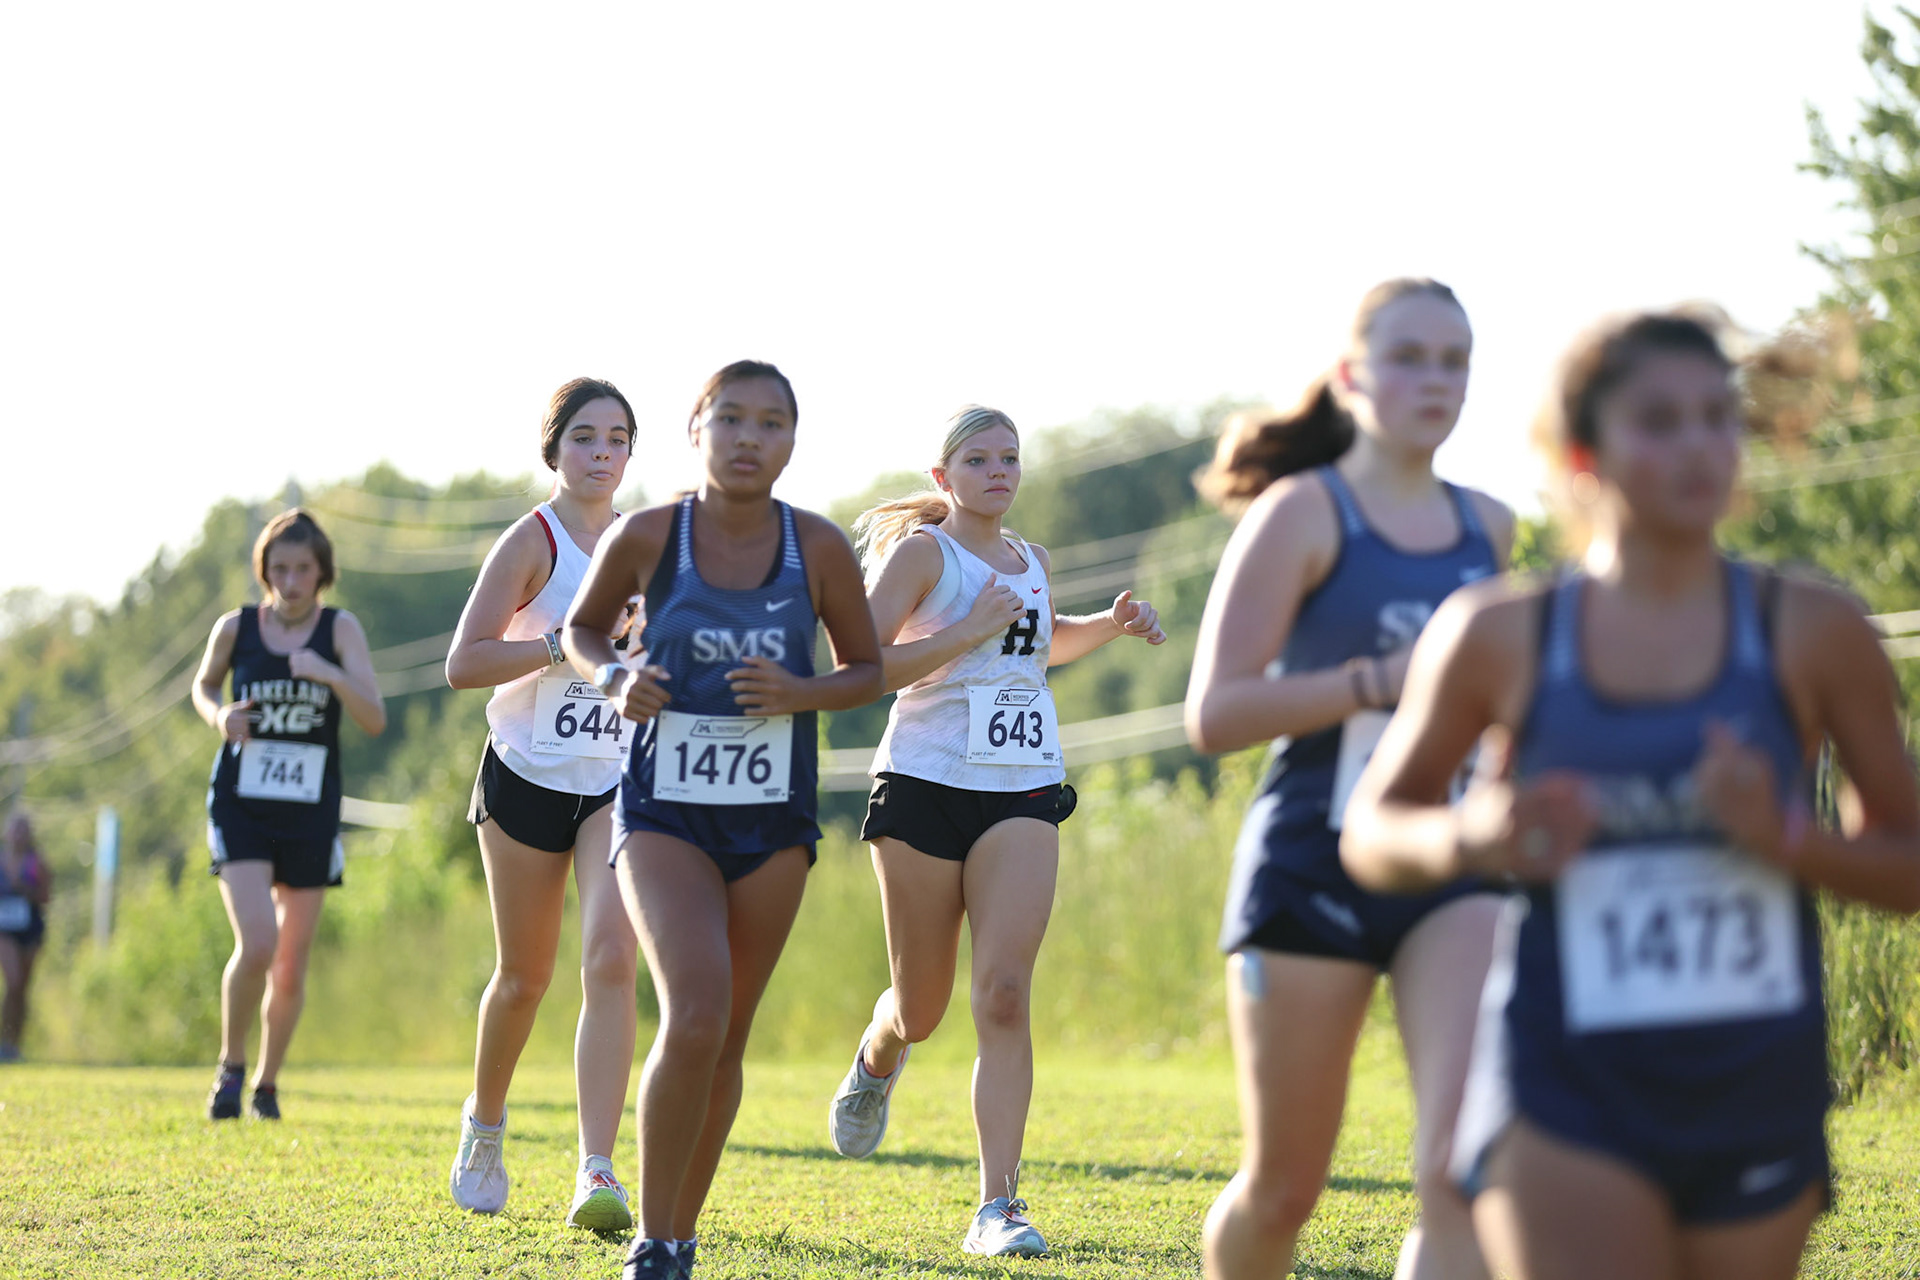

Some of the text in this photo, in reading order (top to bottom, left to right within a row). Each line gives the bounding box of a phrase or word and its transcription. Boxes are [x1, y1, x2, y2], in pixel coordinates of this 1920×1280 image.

[692, 627, 786, 662] SMS
[1001, 609, 1039, 656] H
[258, 702, 316, 734] XC
[555, 702, 622, 742] 644
[988, 710, 1043, 748] 643
[259, 756, 304, 786] 744
[675, 741, 771, 785] 1476
[1600, 893, 1766, 985] 1473
